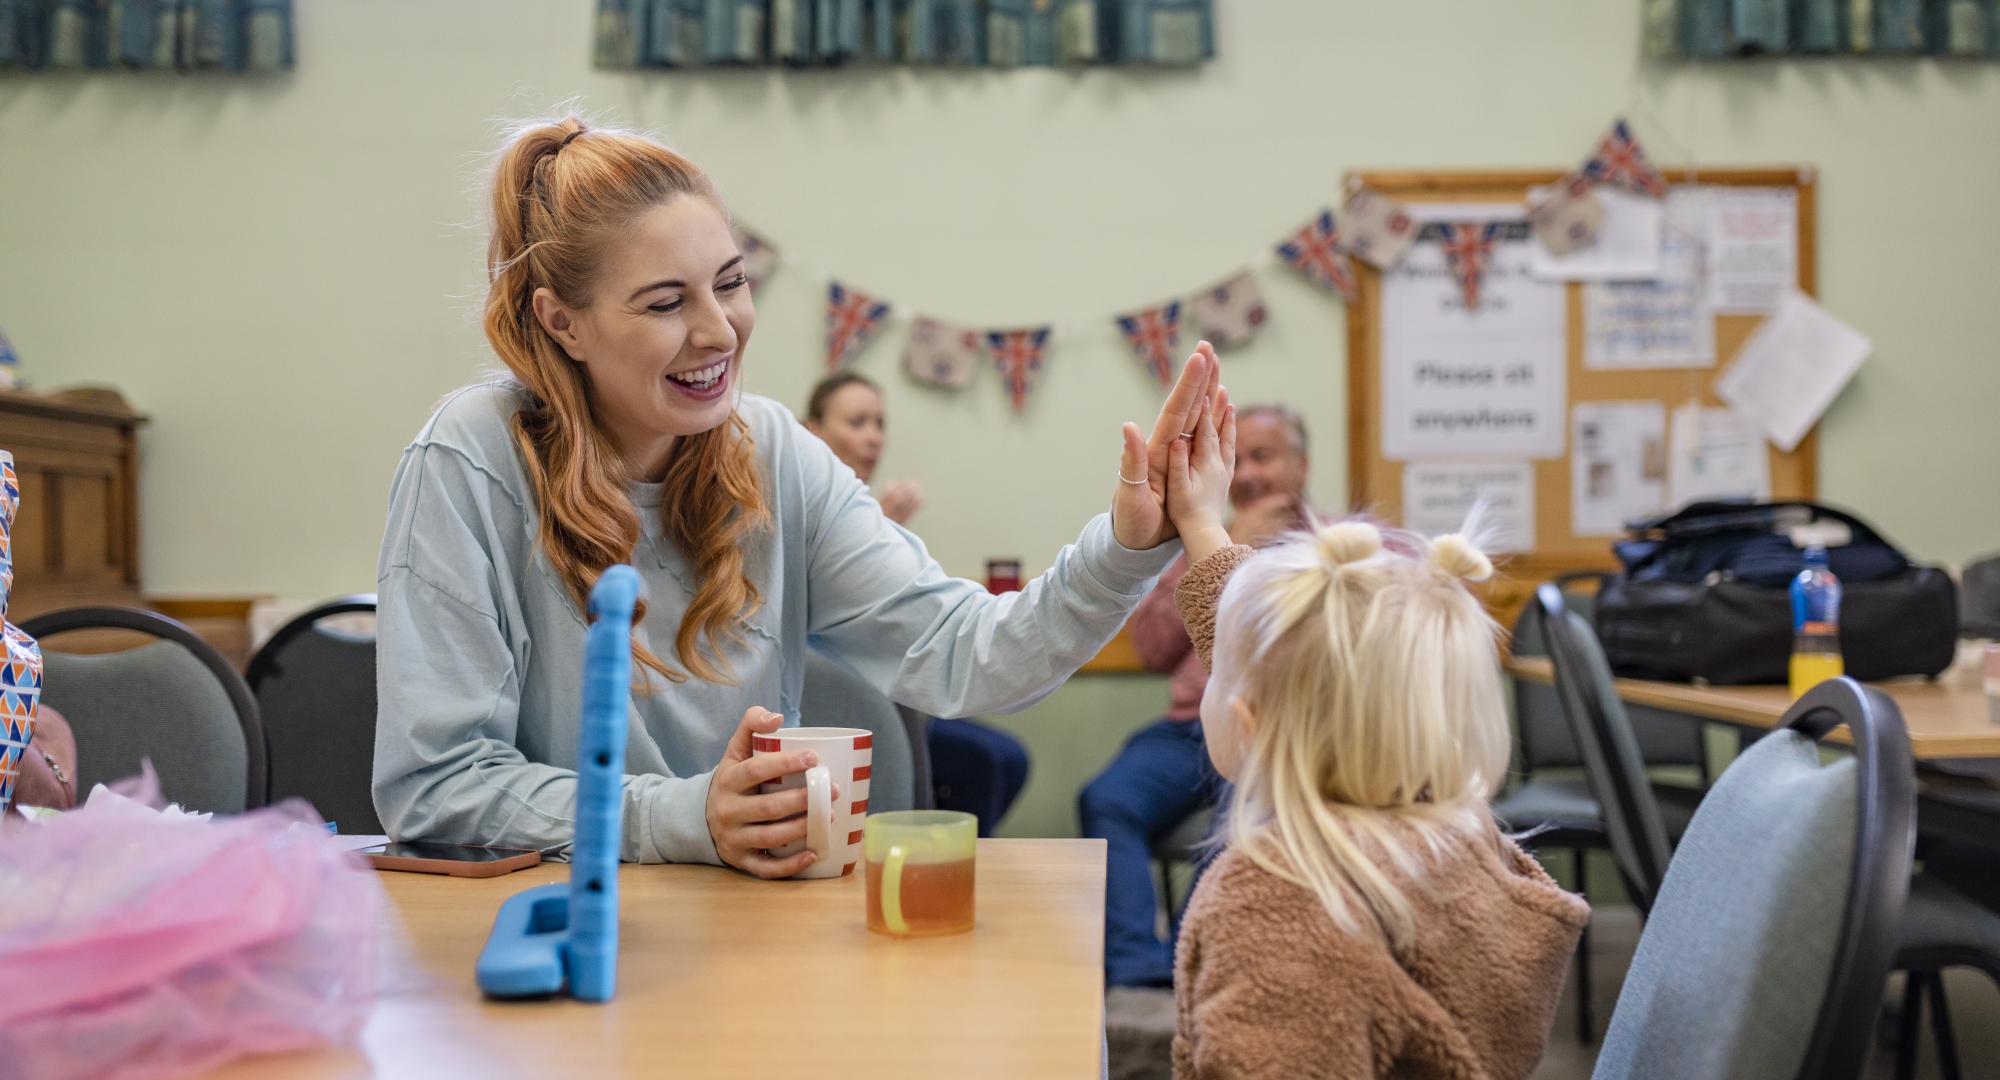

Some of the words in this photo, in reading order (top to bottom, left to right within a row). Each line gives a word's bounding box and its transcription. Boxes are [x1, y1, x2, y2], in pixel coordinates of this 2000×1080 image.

[1414, 361, 1496, 386] Please
[1503, 361, 1534, 386] sit
[1412, 405, 1536, 433] anywhere
